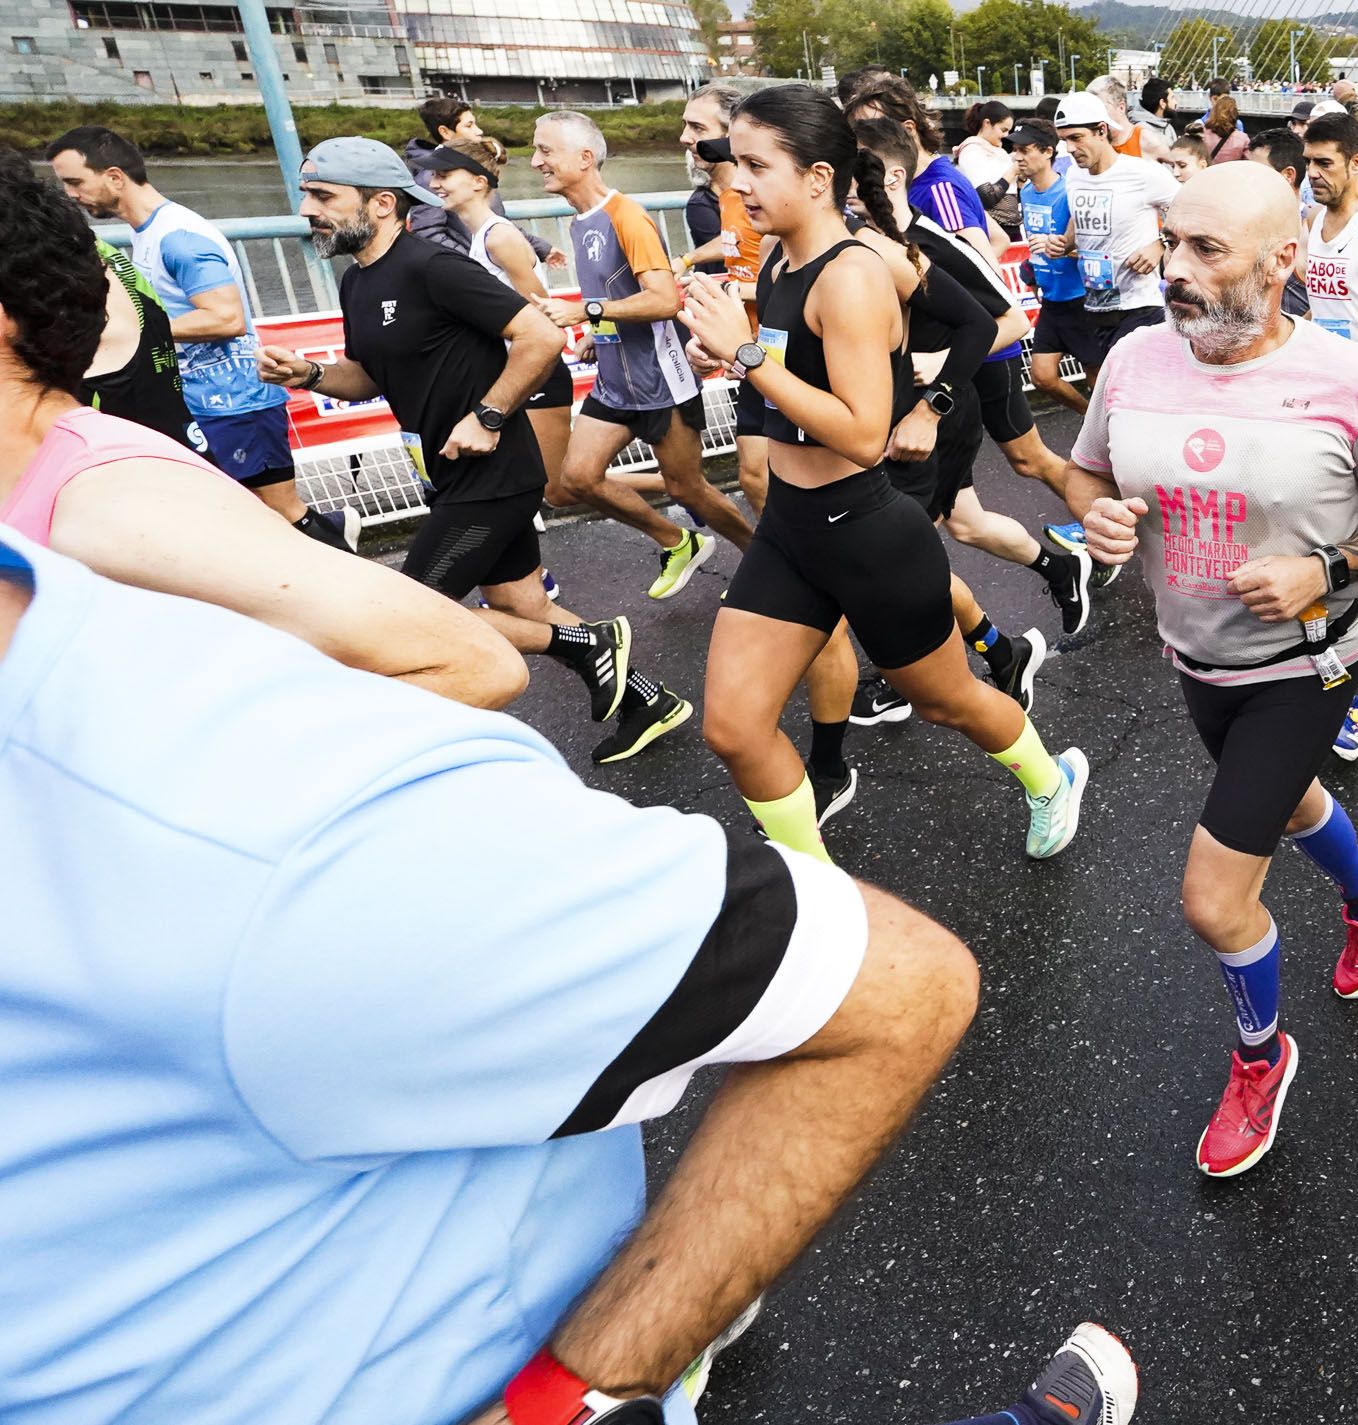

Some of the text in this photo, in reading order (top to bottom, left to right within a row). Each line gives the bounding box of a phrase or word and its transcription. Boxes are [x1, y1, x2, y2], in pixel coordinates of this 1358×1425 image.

[1075, 210, 1108, 231] life!
[1335, 266, 1346, 275] DE
[668, 349, 686, 383] Galicia
[1154, 483, 1248, 544] MMP
[1163, 532, 1249, 561] MEDIO MARATON
